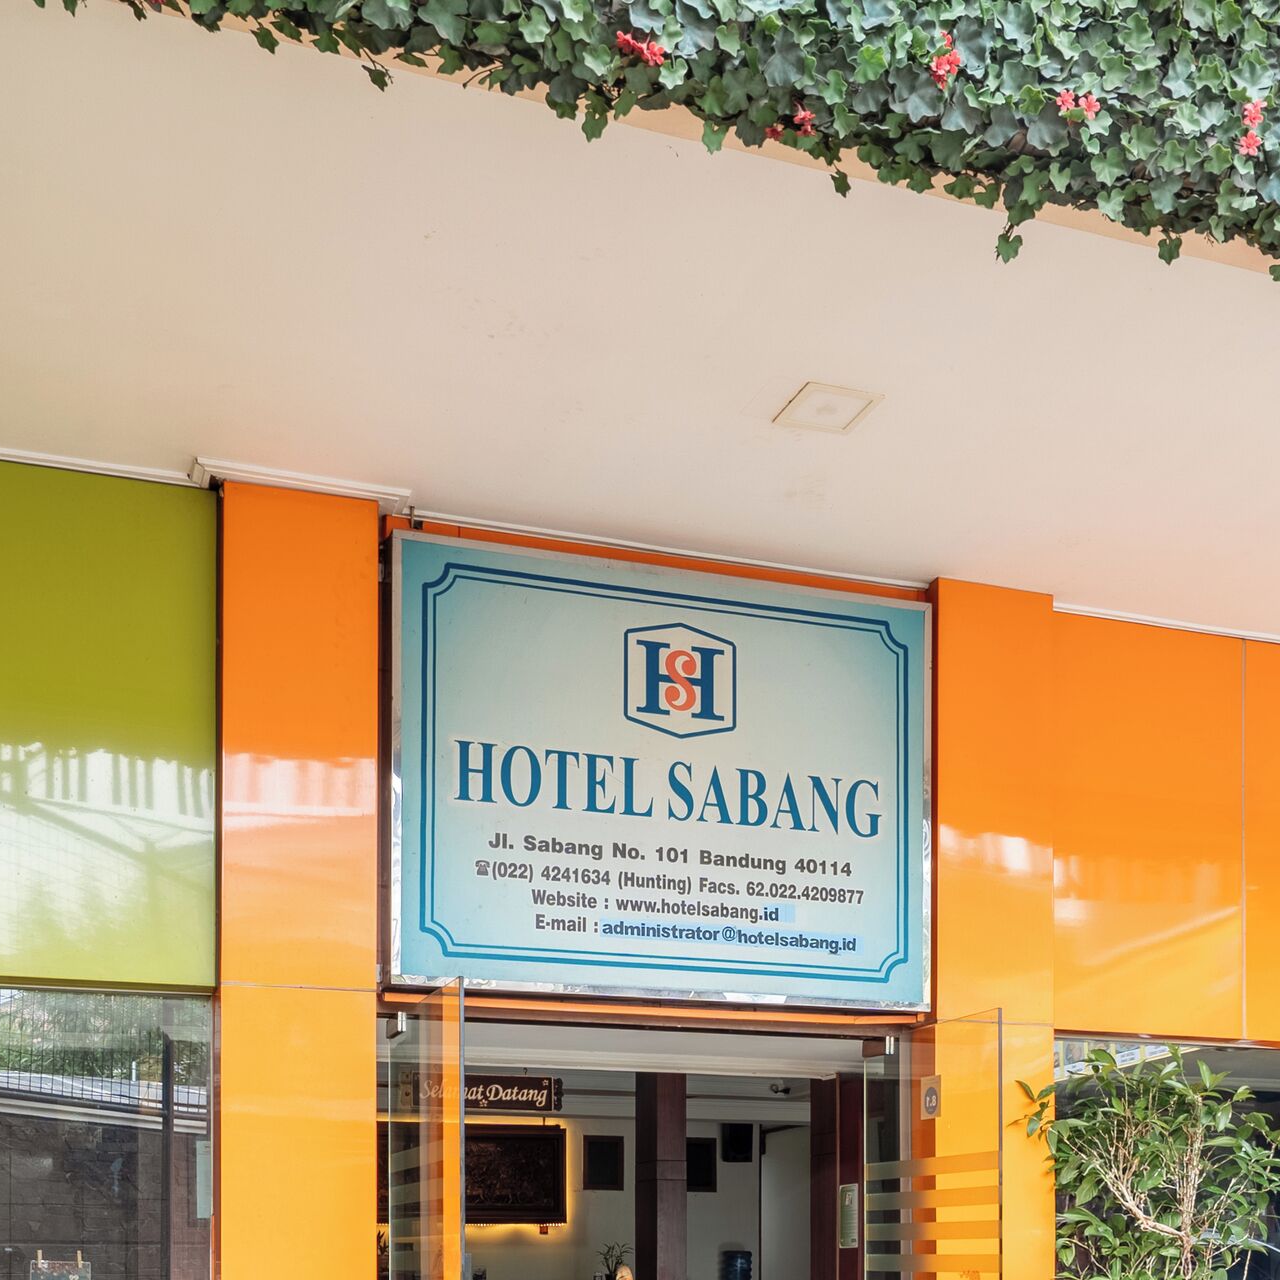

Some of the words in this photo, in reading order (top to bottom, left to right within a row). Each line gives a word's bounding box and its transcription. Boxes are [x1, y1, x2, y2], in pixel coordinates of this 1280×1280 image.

[453, 739, 654, 818] HOTEL
[667, 760, 882, 838] SABANG
[523, 835, 603, 861] Sabang
[612, 842, 646, 861] No.
[655, 847, 688, 864] 101
[699, 849, 787, 875] Bandung
[794, 858, 852, 877] 40114
[491, 861, 534, 883] (022)
[540, 865, 611, 886] 4241634
[618, 870, 692, 896] (Hunting)
[699, 877, 740, 896] Facs.
[746, 880, 864, 905] 62.022.4209877
[531, 888, 597, 909] Website
[615, 898, 780, 924] www.hotelsabang.id
[535, 913, 587, 933] E-mail
[486, 1084, 548, 1107] Datang
